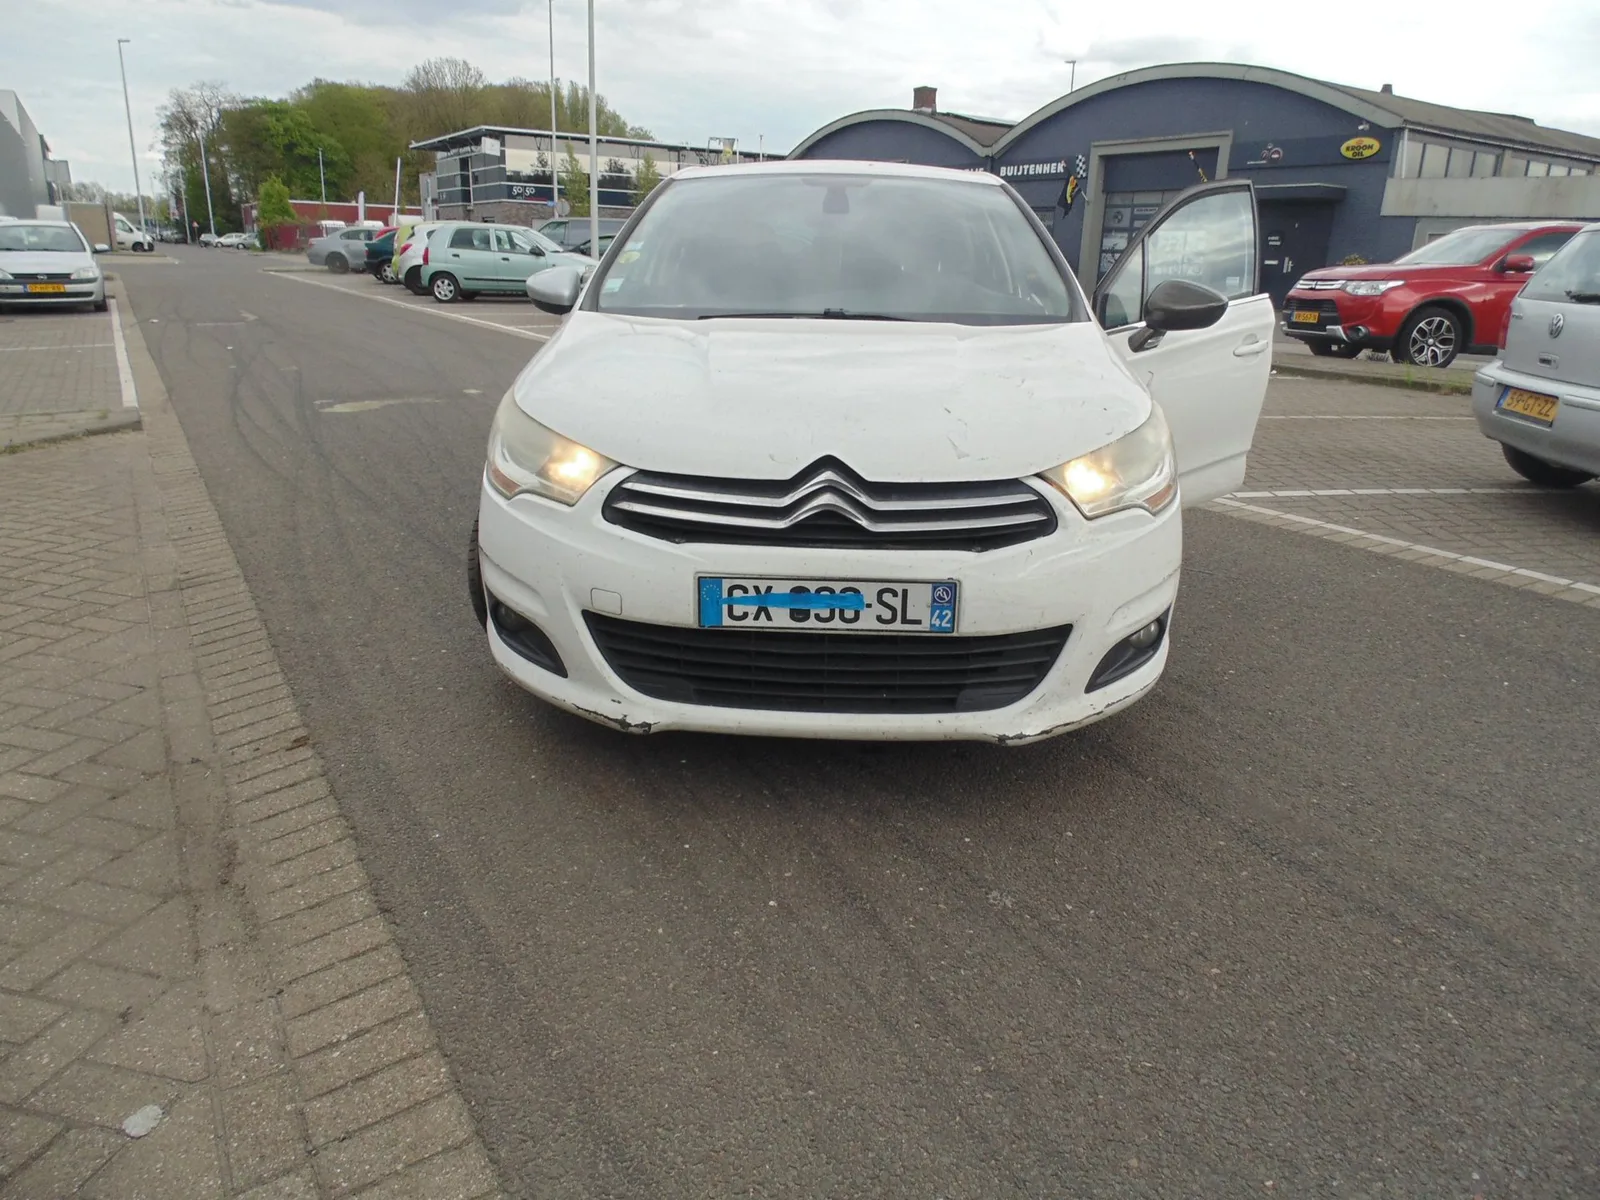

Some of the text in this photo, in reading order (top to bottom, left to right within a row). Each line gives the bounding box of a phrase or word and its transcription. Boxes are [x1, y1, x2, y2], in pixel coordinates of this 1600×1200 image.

[1345, 143, 1374, 152] KROON
[999, 162, 1064, 176] BUIJTENHEK
[930, 609, 951, 627] 42
